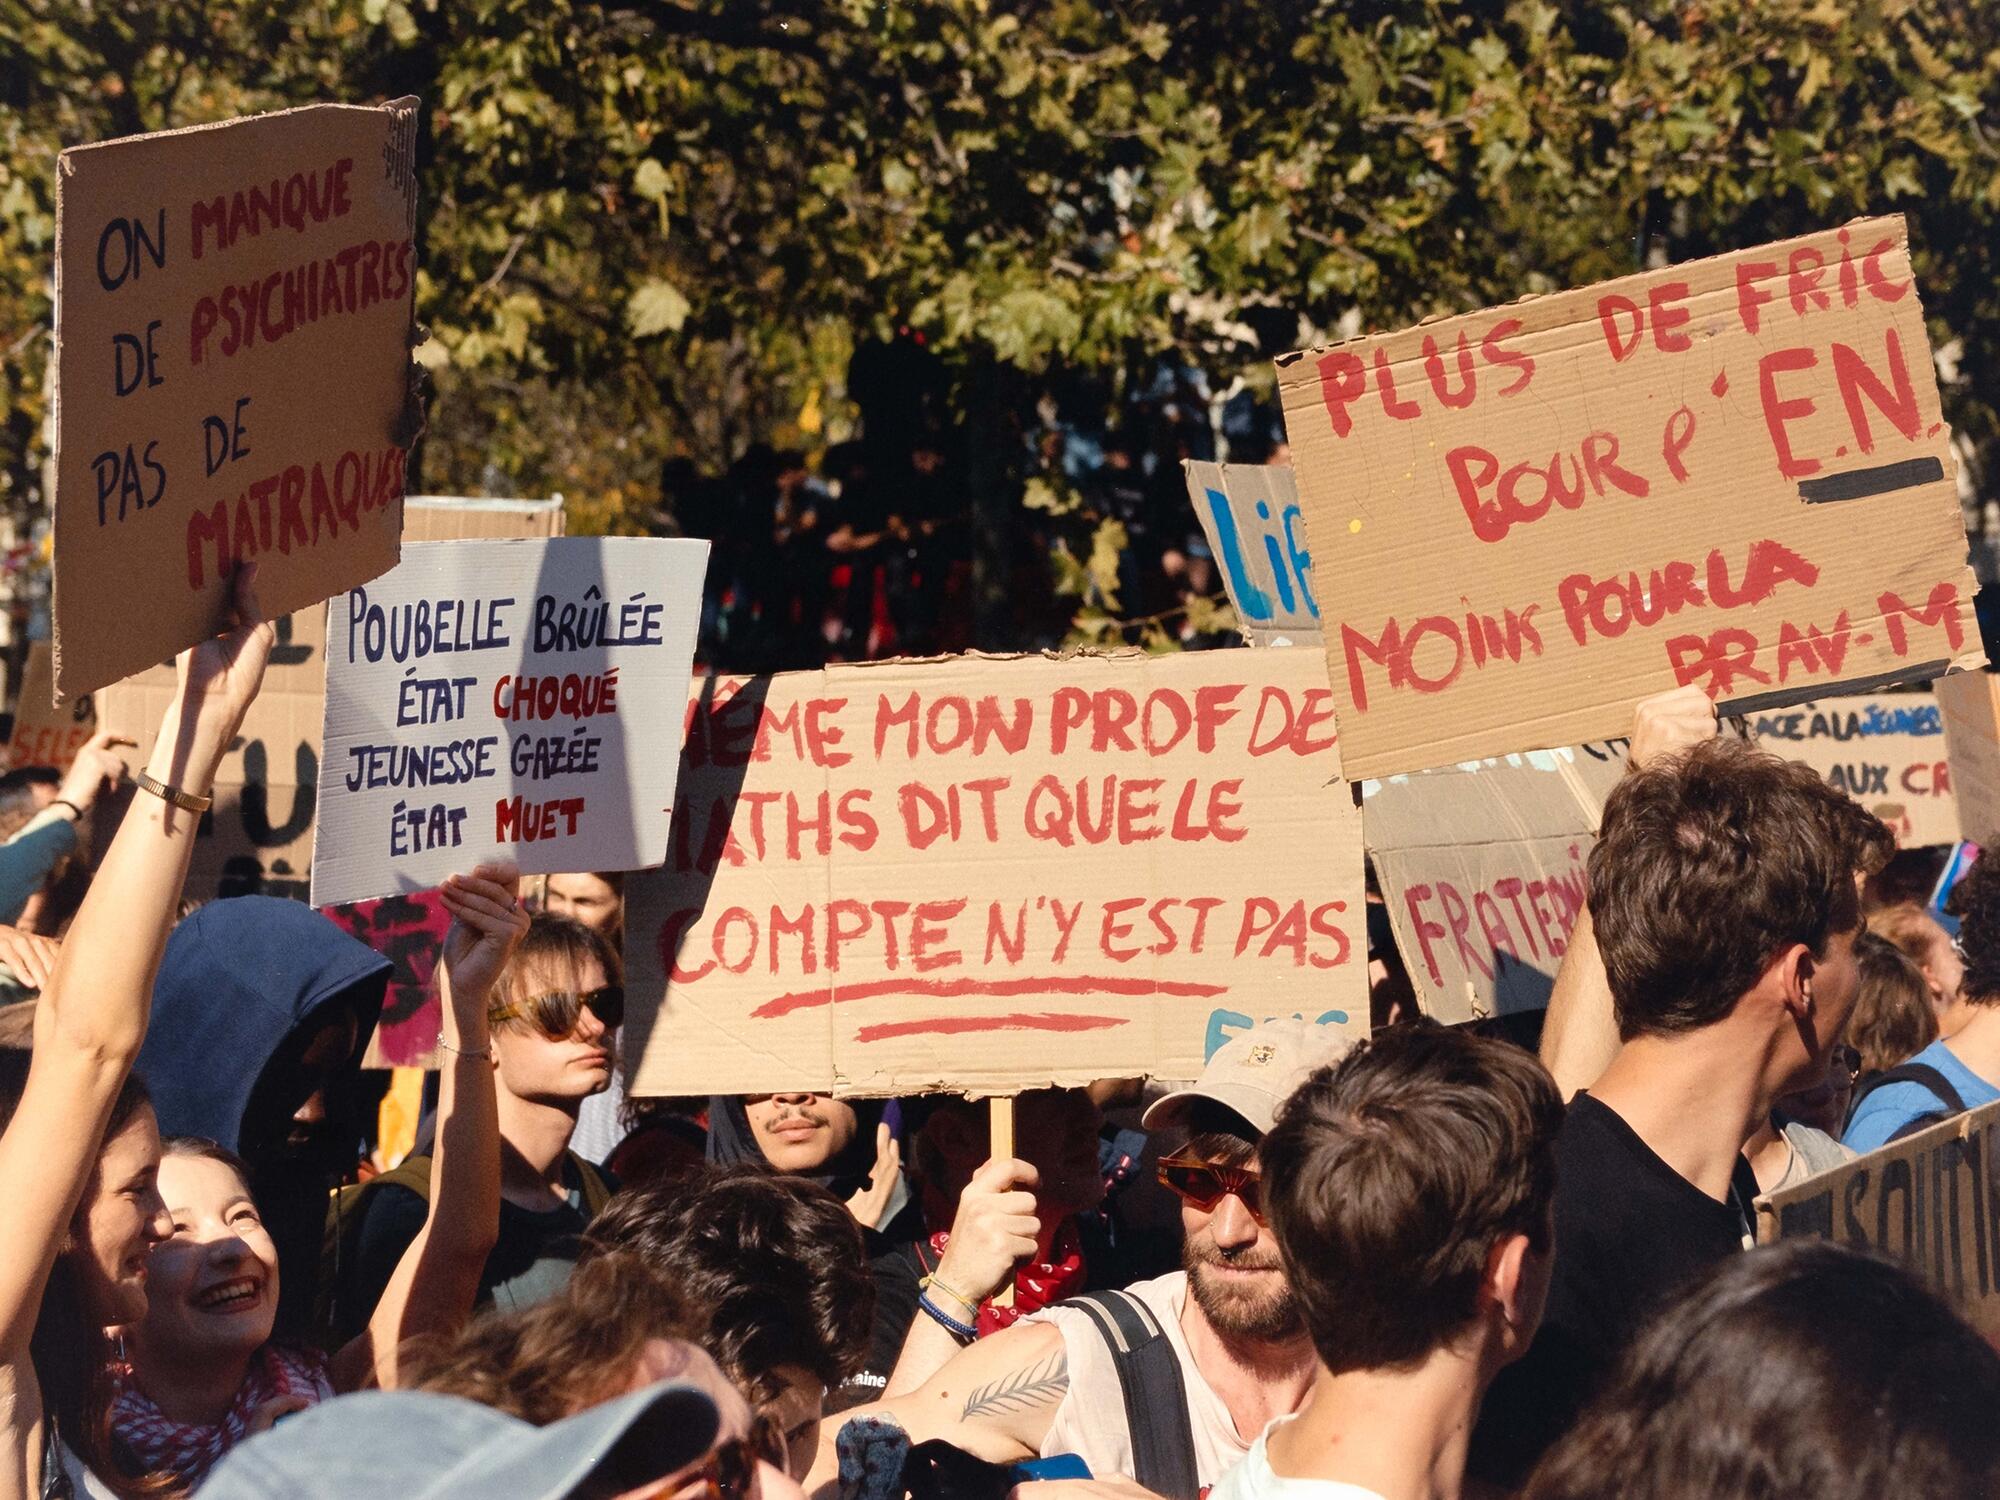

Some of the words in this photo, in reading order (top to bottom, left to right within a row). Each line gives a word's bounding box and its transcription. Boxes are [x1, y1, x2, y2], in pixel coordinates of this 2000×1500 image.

[96, 208, 166, 291] ON
[191, 157, 353, 260] MANQUE
[112, 320, 164, 397] DE
[190, 239, 412, 365] PSYCHIATRES
[1318, 318, 1535, 438] PLUS
[1598, 282, 1692, 362] DE
[91, 440, 166, 527] PAS
[202, 397, 251, 478] DE
[1446, 431, 1649, 543] POUR
[187, 447, 406, 591] MATRAQUES
[349, 586, 515, 663] POUBELLE
[534, 585, 663, 653] BRÛLÉE
[1558, 561, 1705, 646] POUR
[1707, 539, 1820, 609] LA
[397, 667, 477, 727] ÉTAT
[494, 667, 619, 721] CHOQUÉ
[874, 690, 1033, 759] MON
[1050, 684, 1248, 756] PROF
[1248, 686, 1337, 758] DE
[346, 736, 498, 792] JEUNESSE
[511, 727, 601, 779] GAZÉE
[1828, 762, 1888, 795] AUX
[390, 800, 467, 857] ÉTAT
[496, 796, 584, 843] MUET
[899, 777, 1011, 850] DIT
[1025, 774, 1166, 848] QUE
[1171, 778, 1249, 843] LE
[657, 896, 967, 984] COMPTE
[983, 895, 1082, 965] N'Y
[1102, 898, 1228, 962] EST
[1234, 898, 1350, 969] PAS
